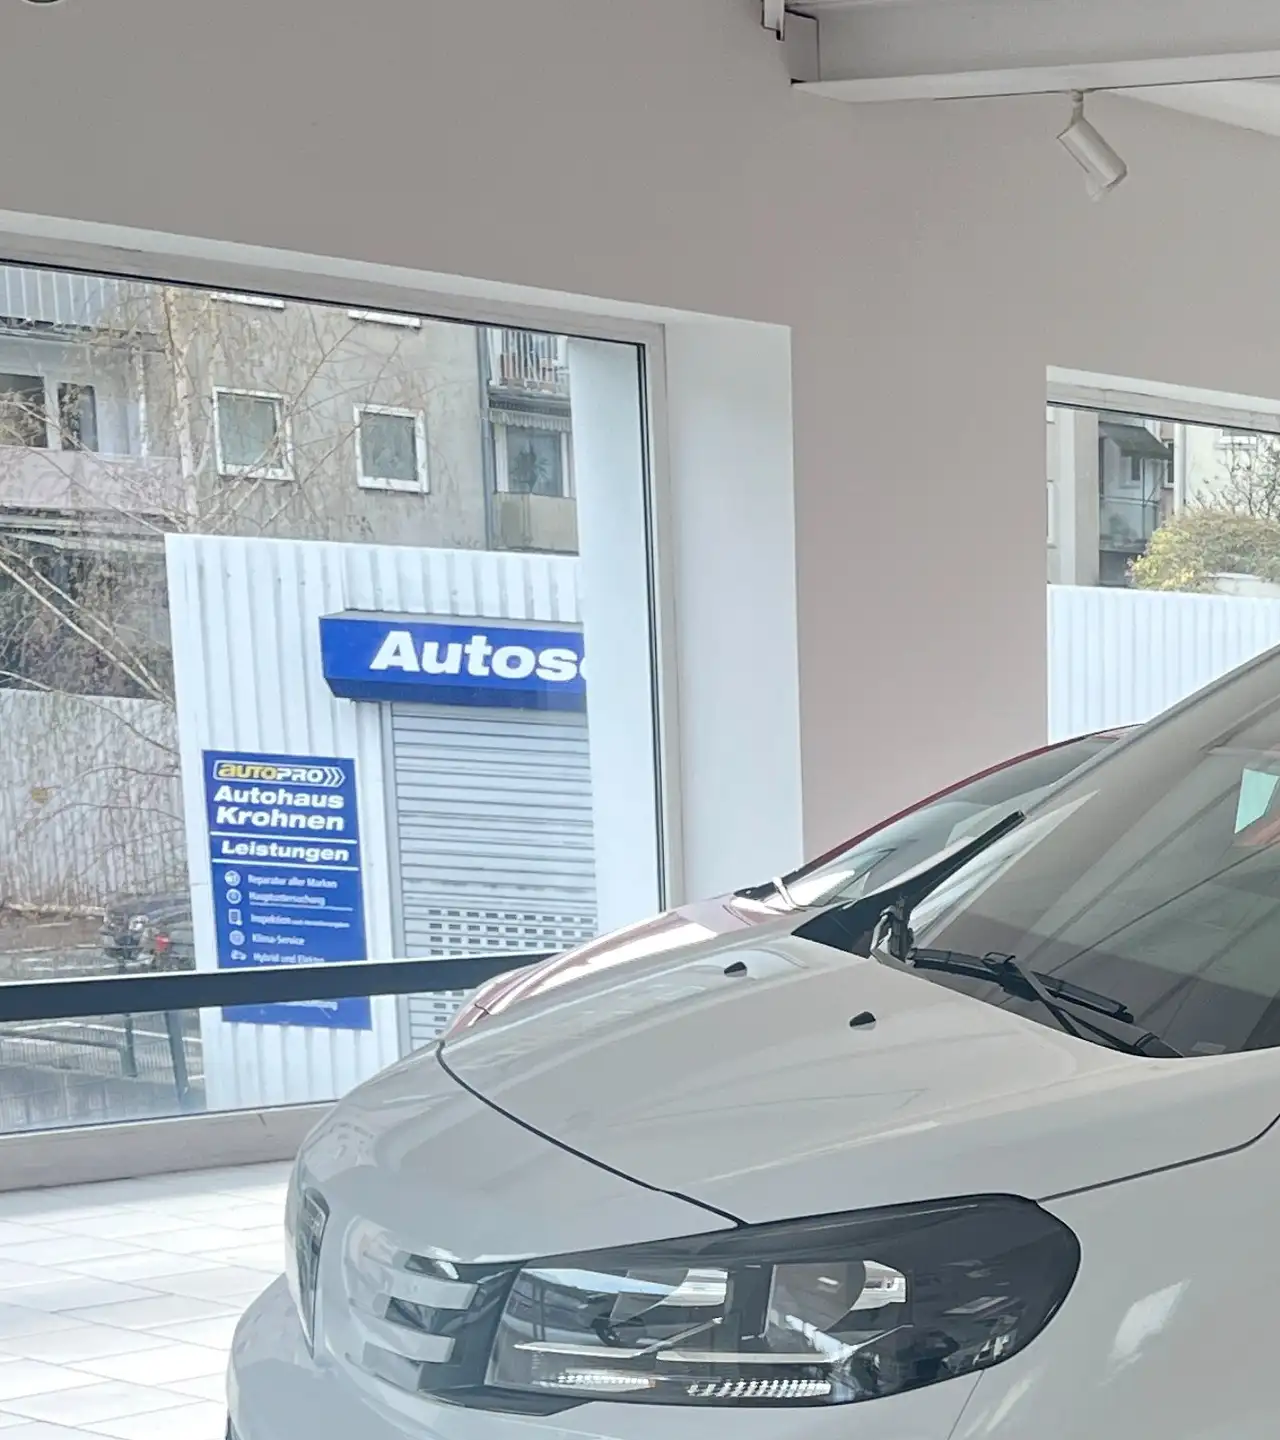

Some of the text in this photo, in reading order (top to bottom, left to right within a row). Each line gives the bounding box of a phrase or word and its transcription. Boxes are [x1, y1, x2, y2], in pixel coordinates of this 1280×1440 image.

[369, 630, 587, 682] Autos
[213, 785, 345, 809] Autohaus
[216, 806, 345, 831] Krohnen
[221, 840, 350, 863] Leistungen
